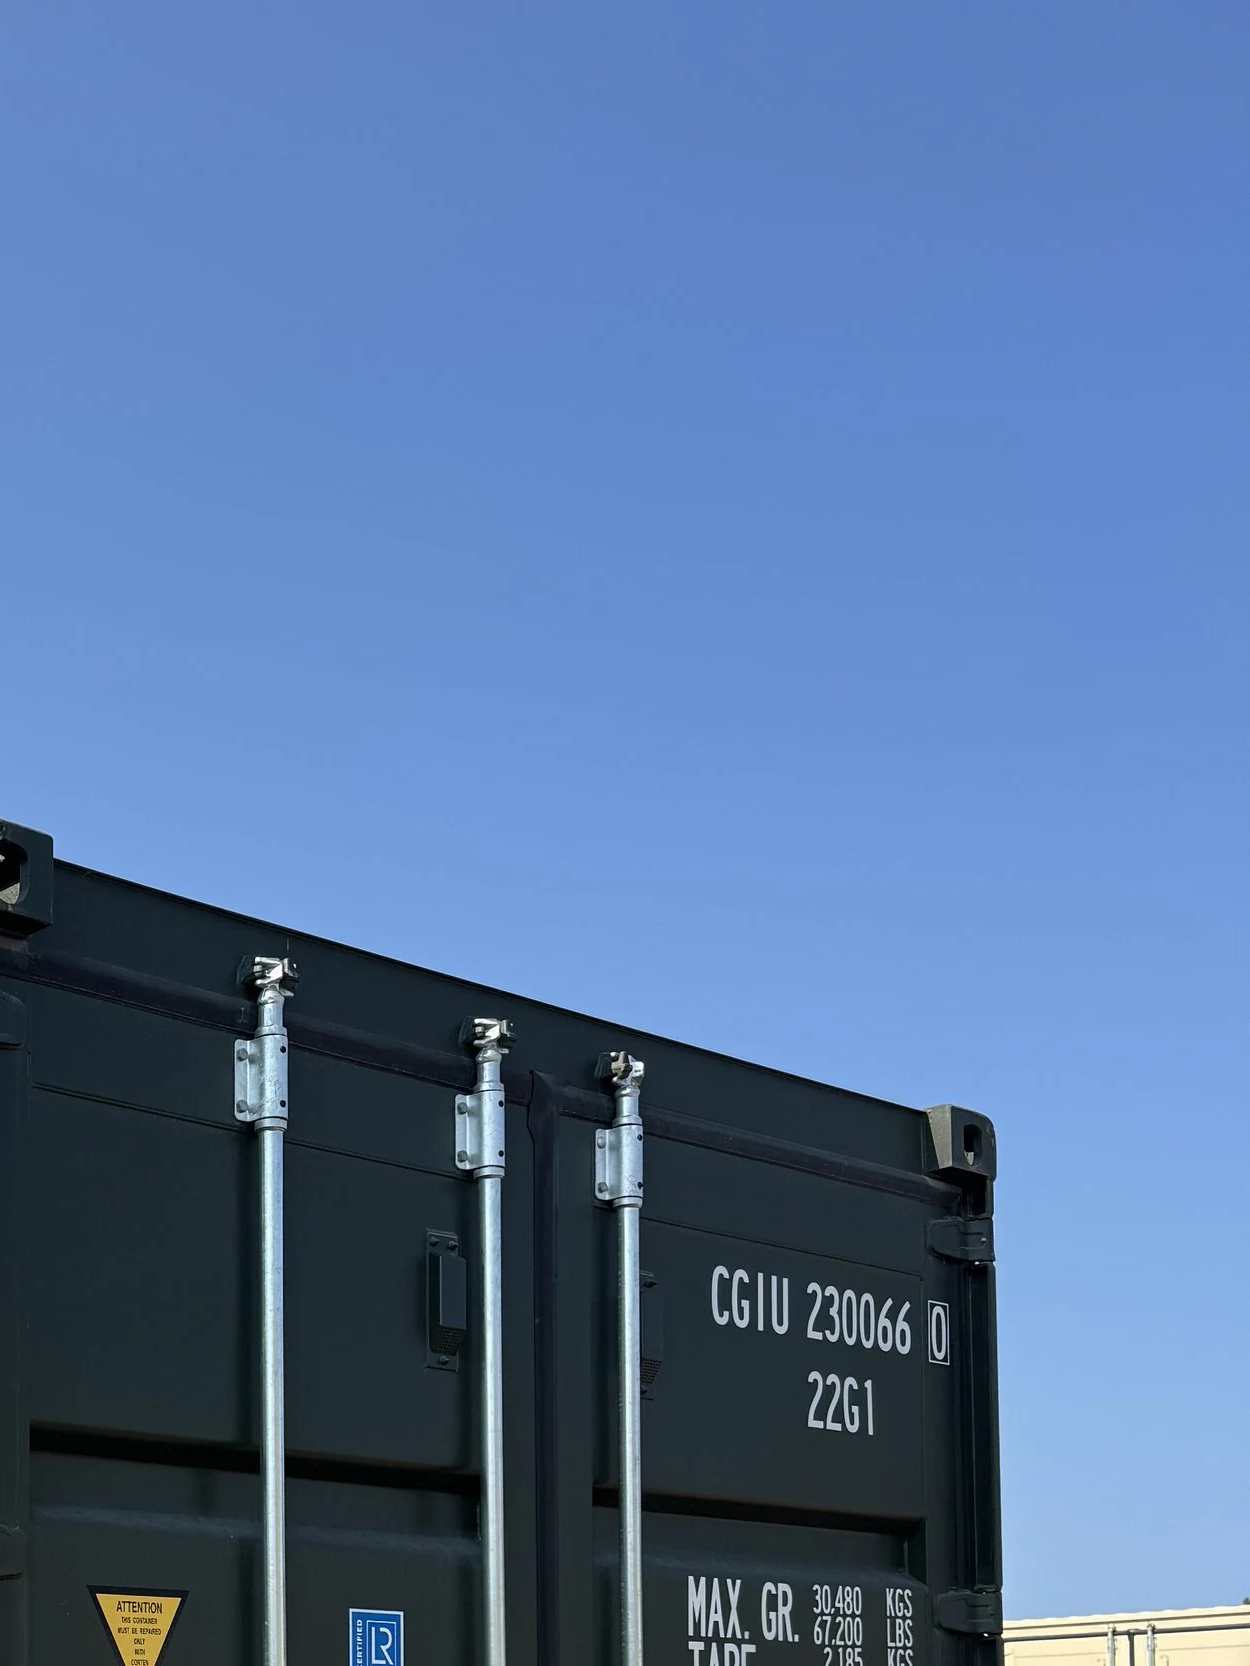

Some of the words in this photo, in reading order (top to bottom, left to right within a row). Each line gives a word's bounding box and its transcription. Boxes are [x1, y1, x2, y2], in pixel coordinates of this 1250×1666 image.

[711, 1265, 789, 1335] CGIU
[806, 1281, 912, 1355] 230066
[931, 1305, 947, 1360] 0
[807, 1370, 874, 1436] 22G1
[116, 1600, 162, 1614] ATTENTION
[132, 1617, 158, 1625] CONTAINER
[688, 1575, 749, 1639] MAX.
[761, 1581, 799, 1643] GR.
[813, 1584, 862, 1616] 30,480
[886, 1588, 913, 1618] KGS
[371, 1626, 394, 1666] LR
[813, 1616, 862, 1646] 67,200
[887, 1618, 913, 1648] LBS
